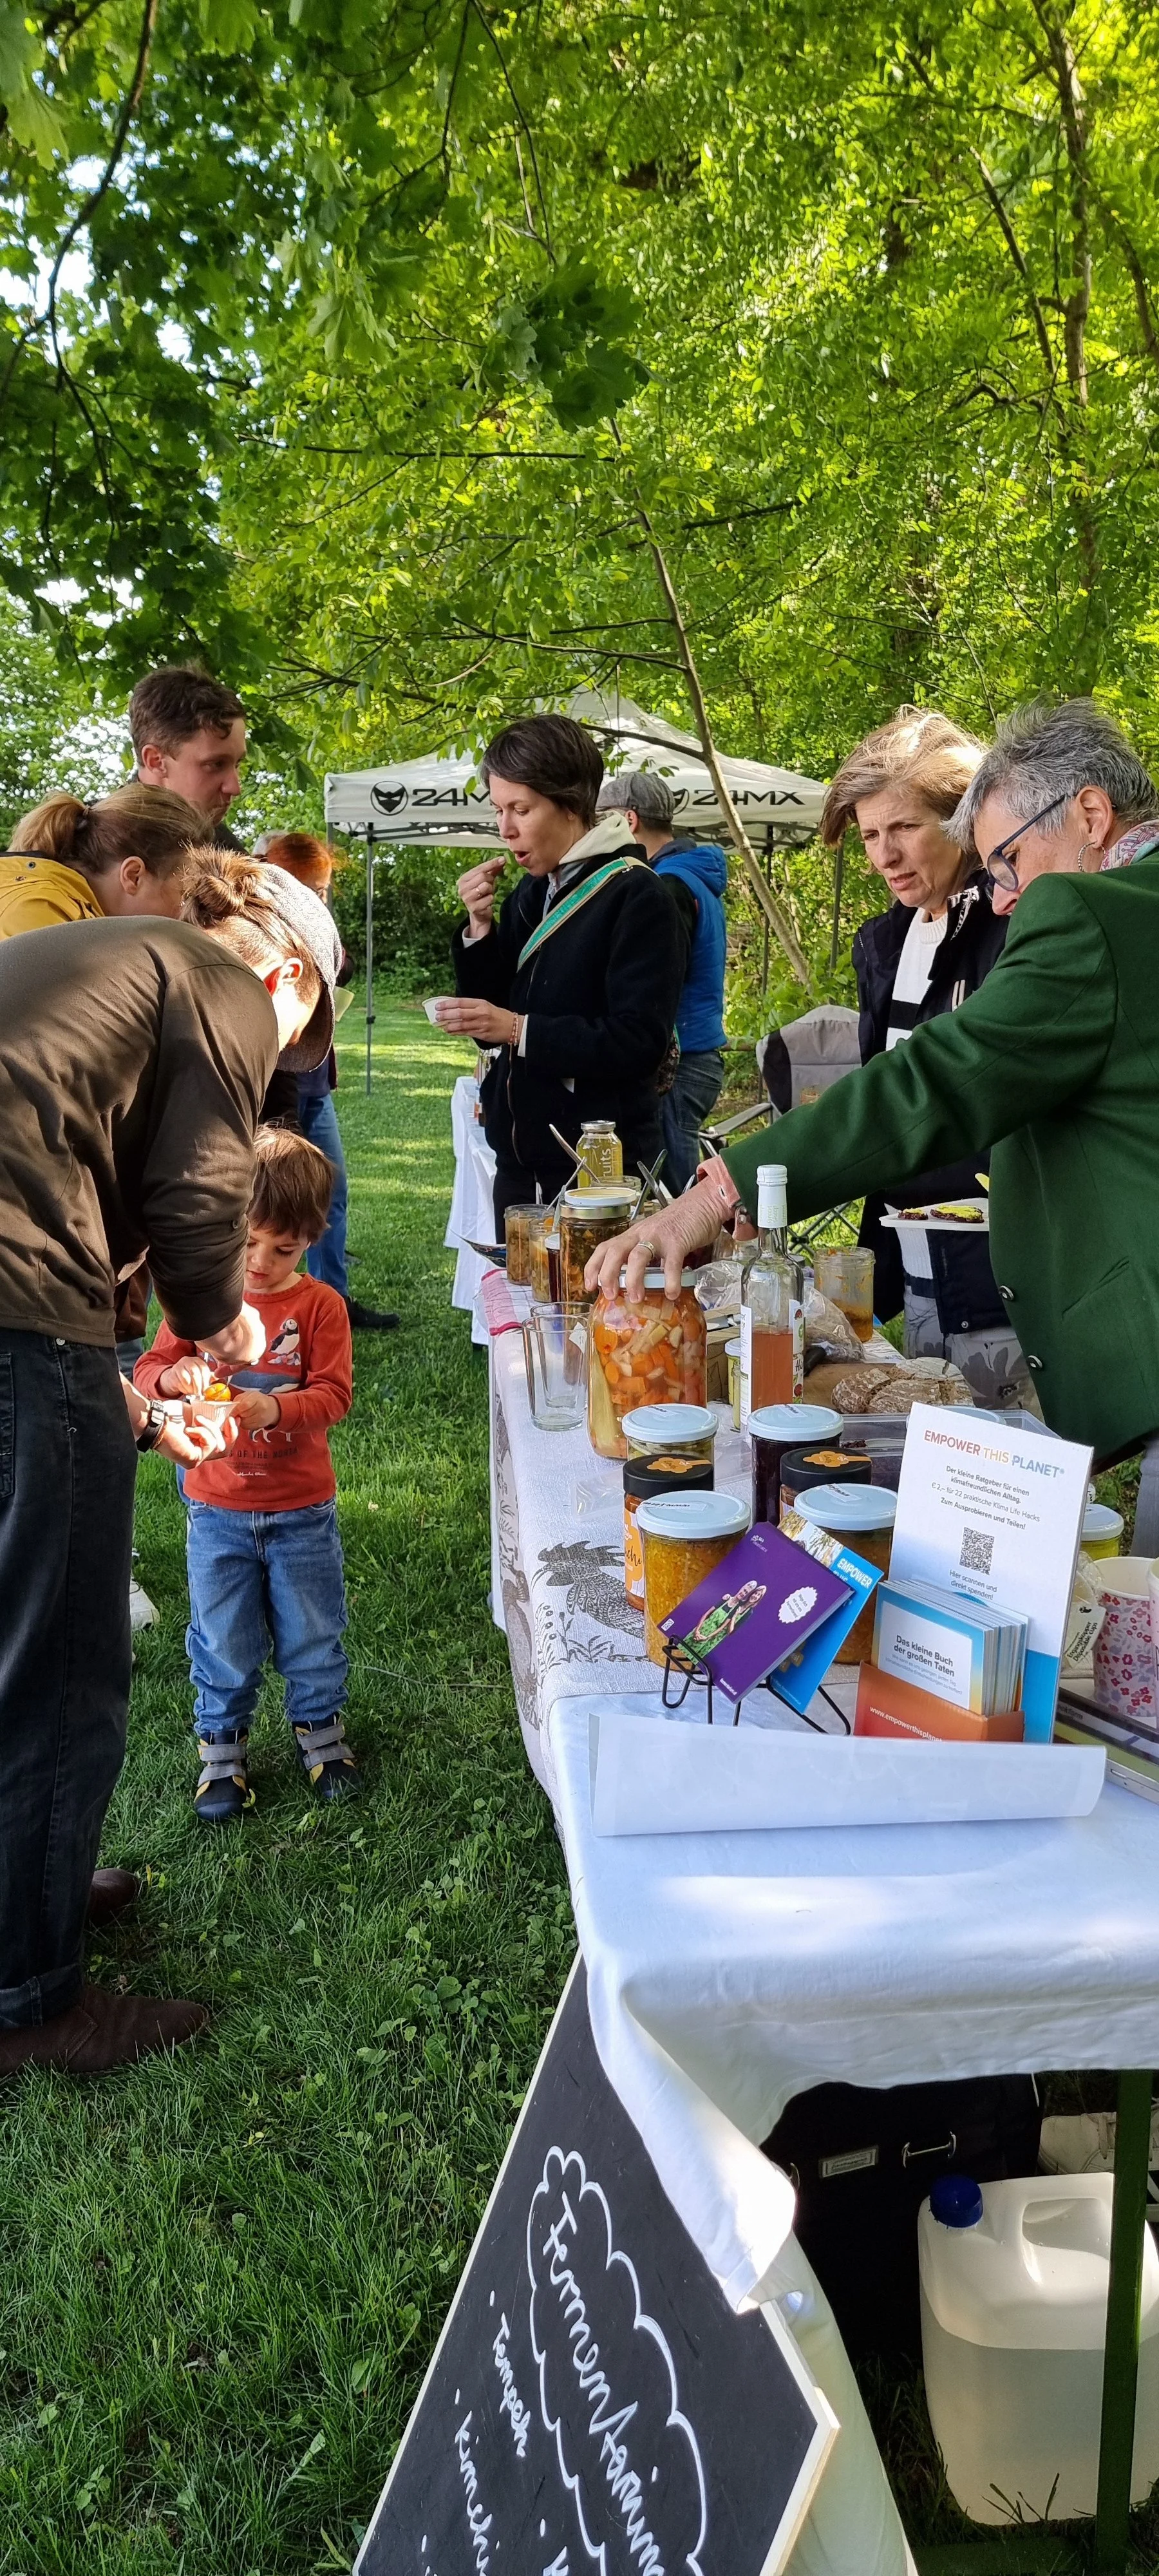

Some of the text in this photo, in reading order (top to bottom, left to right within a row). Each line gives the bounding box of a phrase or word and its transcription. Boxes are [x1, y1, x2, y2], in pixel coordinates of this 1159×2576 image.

[411, 788, 490, 806] 24M
[924, 1430, 981, 1456] EMPOWER
[983, 1447, 1010, 1463] THIS
[946, 1465, 1030, 1497] Der kleine Ratgeber für einen
[950, 1476, 1001, 1497] klimafreundlichen
[940, 1497, 1026, 1530] Zum Ausprobieren und Teilen!
[946, 1486, 954, 1495] für
[963, 1492, 992, 1507] praktische
[993, 1501, 1009, 1512] Klima
[1010, 1506, 1021, 1516] Life
[1021, 1510, 1041, 1522] Hacks
[837, 1558, 873, 1589] EMPOWER
[949, 1569, 997, 1593] Hier scannen und
[950, 1580, 994, 1601] direkt spenden!
[896, 1634, 954, 1667] Das kleine Buch
[1072, 1635, 1091, 1662] Disposable
[1088, 1622, 1098, 1635] cups
[893, 1643, 955, 1677] der großen Taten
[491, 2311, 531, 2458] Tempeh
